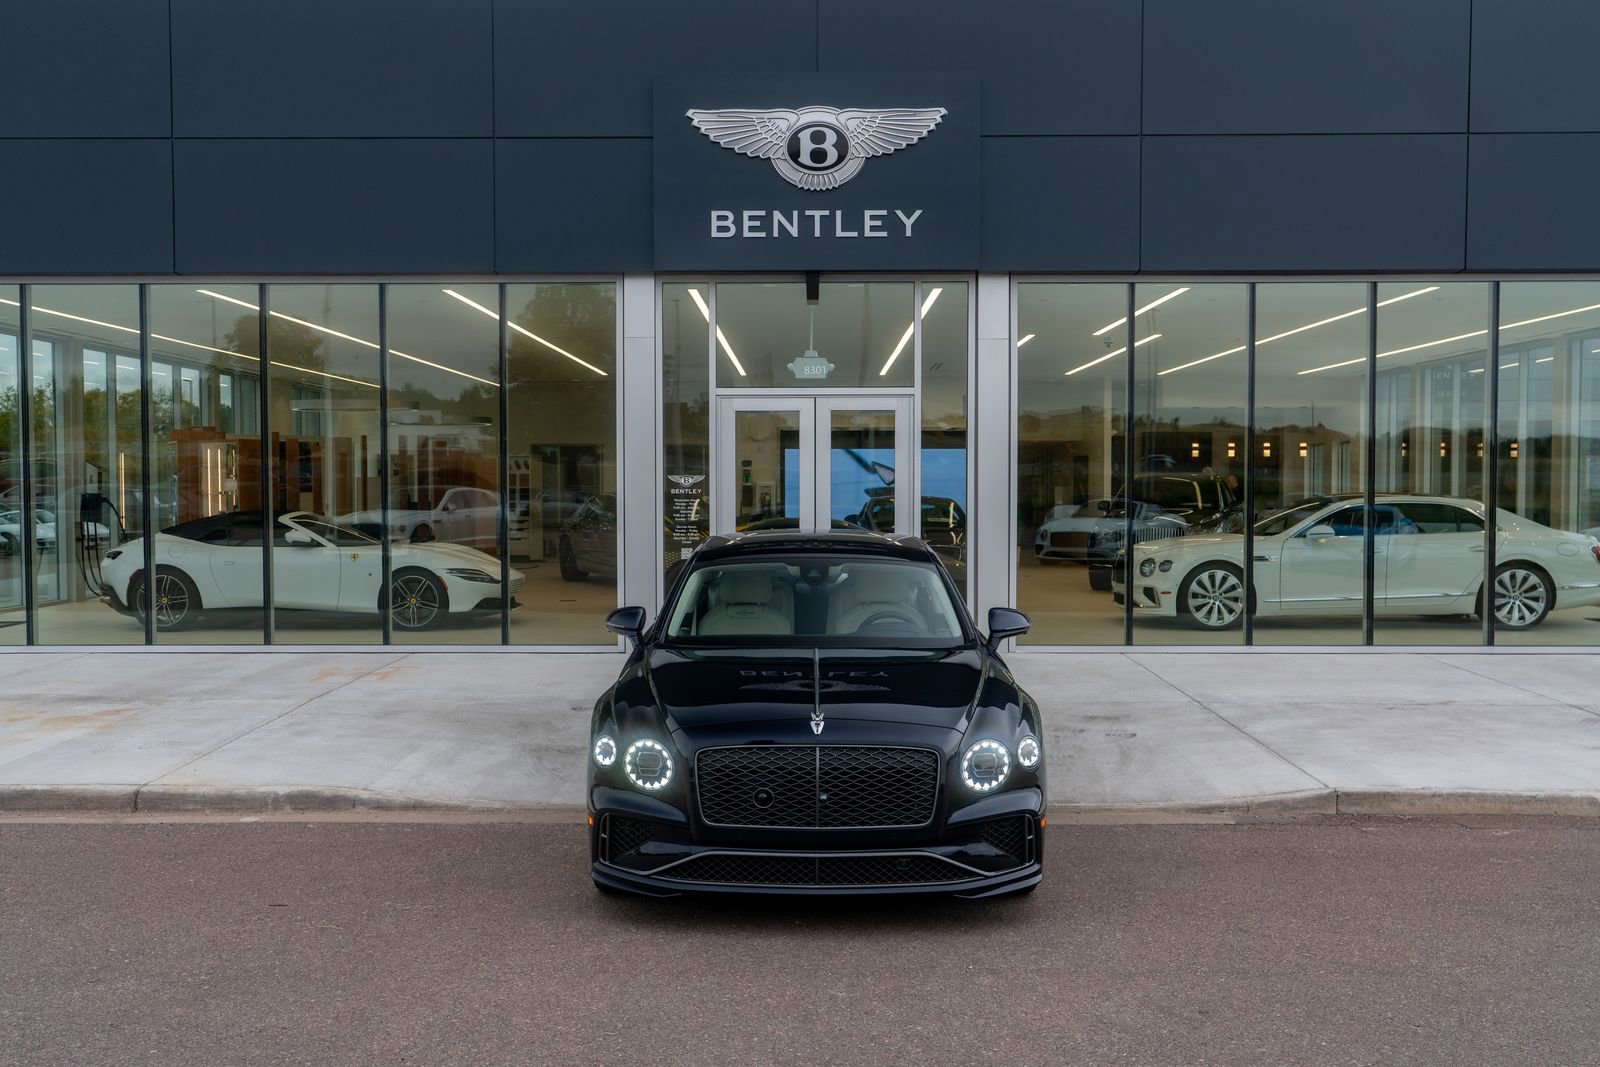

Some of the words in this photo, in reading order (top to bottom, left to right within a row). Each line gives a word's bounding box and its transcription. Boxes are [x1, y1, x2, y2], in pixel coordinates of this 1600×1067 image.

[798, 126, 839, 168] B
[710, 209, 924, 238] BENTLEY
[804, 366, 826, 375] 8301
